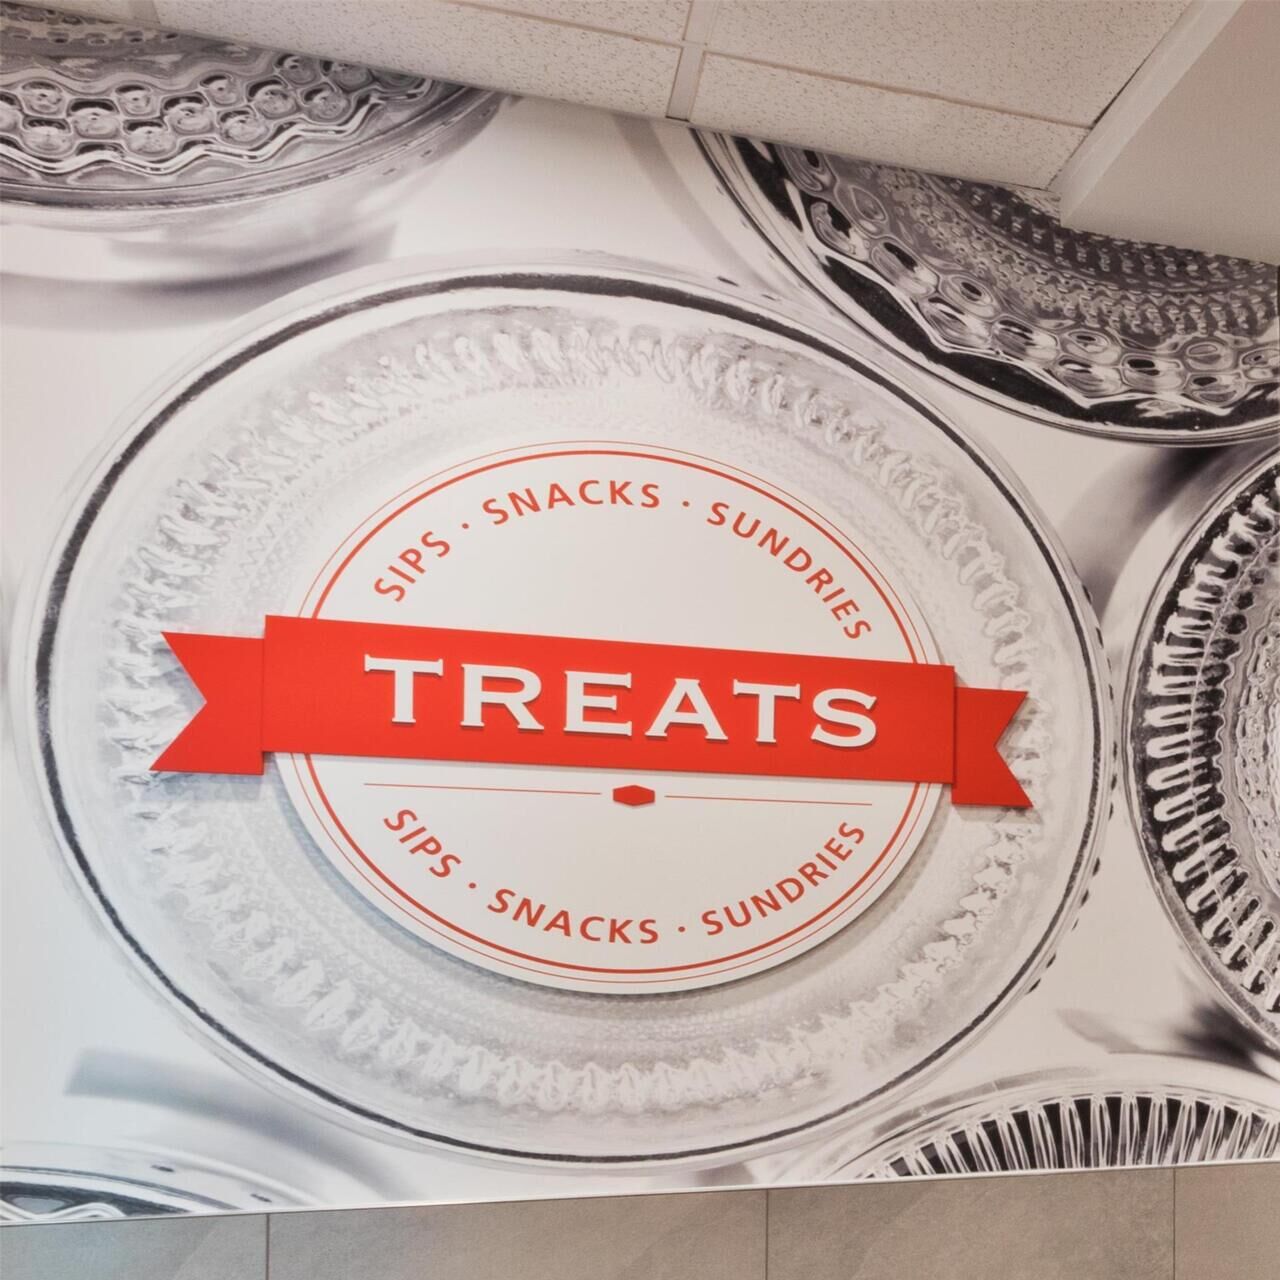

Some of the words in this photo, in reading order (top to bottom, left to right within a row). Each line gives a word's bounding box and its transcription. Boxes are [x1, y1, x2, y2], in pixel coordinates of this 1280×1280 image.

[374, 528, 451, 604] SIPS
[480, 479, 662, 528] SNACKS
[705, 500, 873, 643] SUNDRIES
[363, 653, 879, 748] TREATS
[381, 806, 462, 882] SIPS
[486, 886, 661, 946] SNACKS
[699, 817, 866, 938] SUNDRIES
